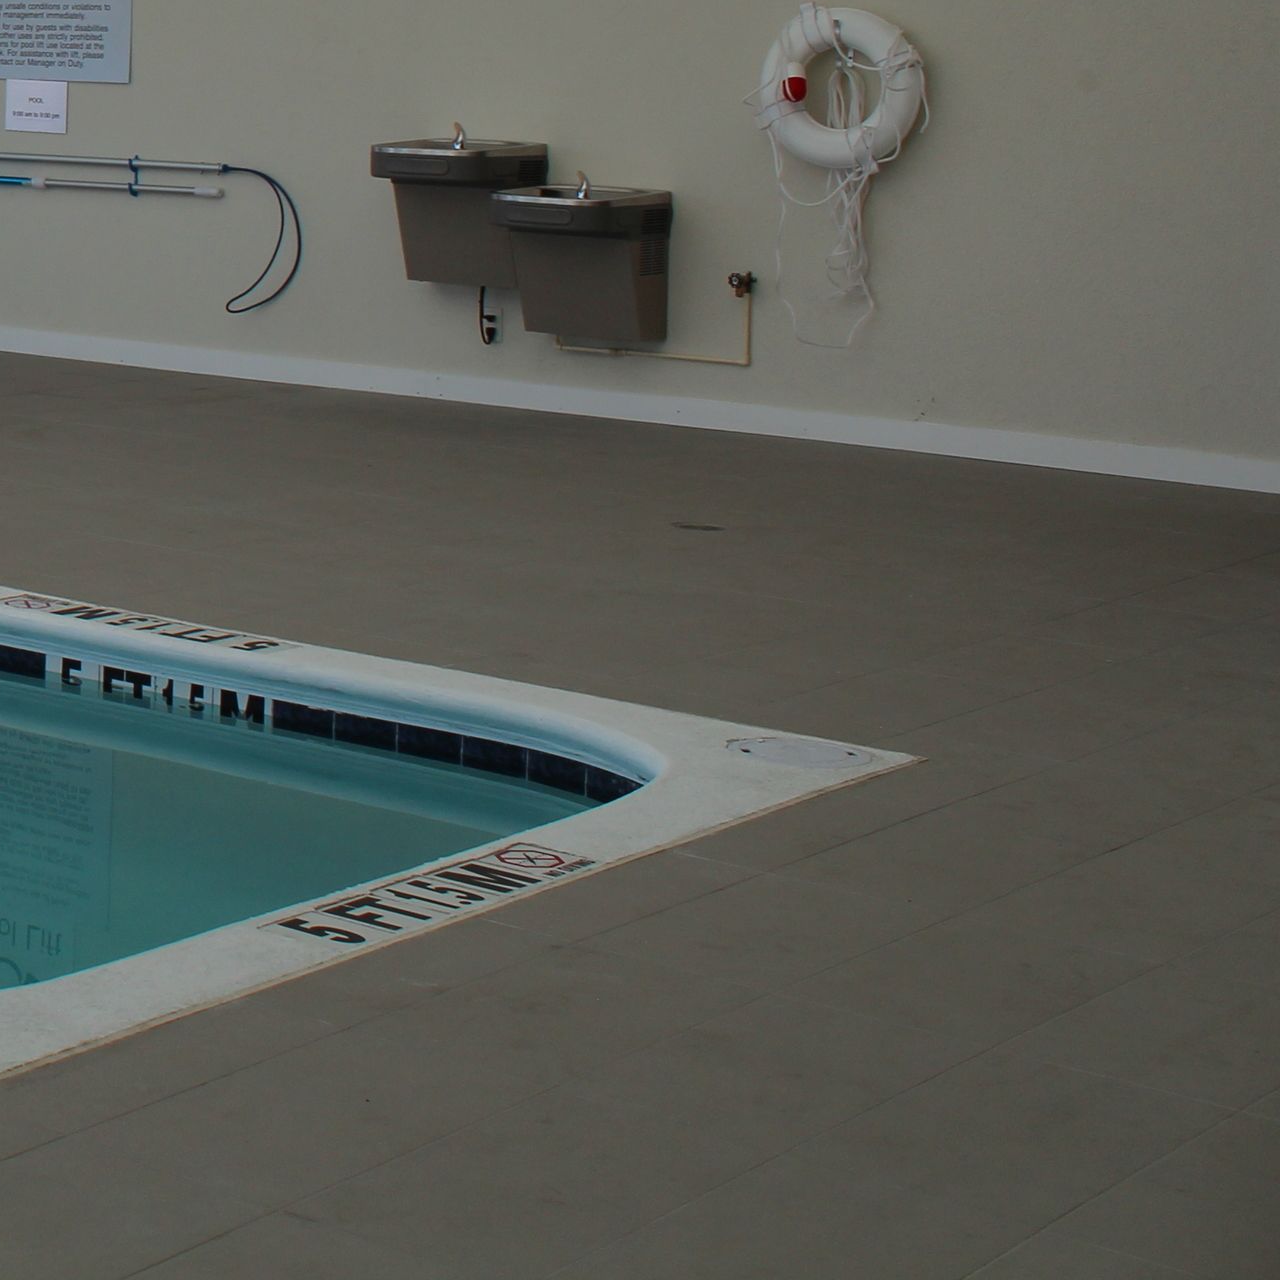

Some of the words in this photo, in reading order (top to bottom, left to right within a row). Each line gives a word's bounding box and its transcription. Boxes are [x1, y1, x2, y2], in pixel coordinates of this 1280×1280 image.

[5, 2, 26, 10] unsafe
[28, 2, 61, 10] conditions
[72, 3, 102, 11] violations
[2, 22, 10, 30] for
[35, 23, 57, 33] guests
[74, 24, 108, 32] disabilities
[0, 31, 16, 39] other
[47, 32, 68, 42] strictly
[10, 40, 19, 48] for
[20, 41, 35, 50] pool
[60, 42, 84, 50] located
[27, 58, 56, 68] Manager
[159, 627, 236, 643] FT
[61, 656, 82, 687] 5
[102, 665, 152, 700] FT
[220, 688, 266, 724] M
[434, 862, 543, 894] M
[385, 879, 485, 910] 1.5
[321, 895, 433, 931] FT
[277, 918, 366, 944] 5
